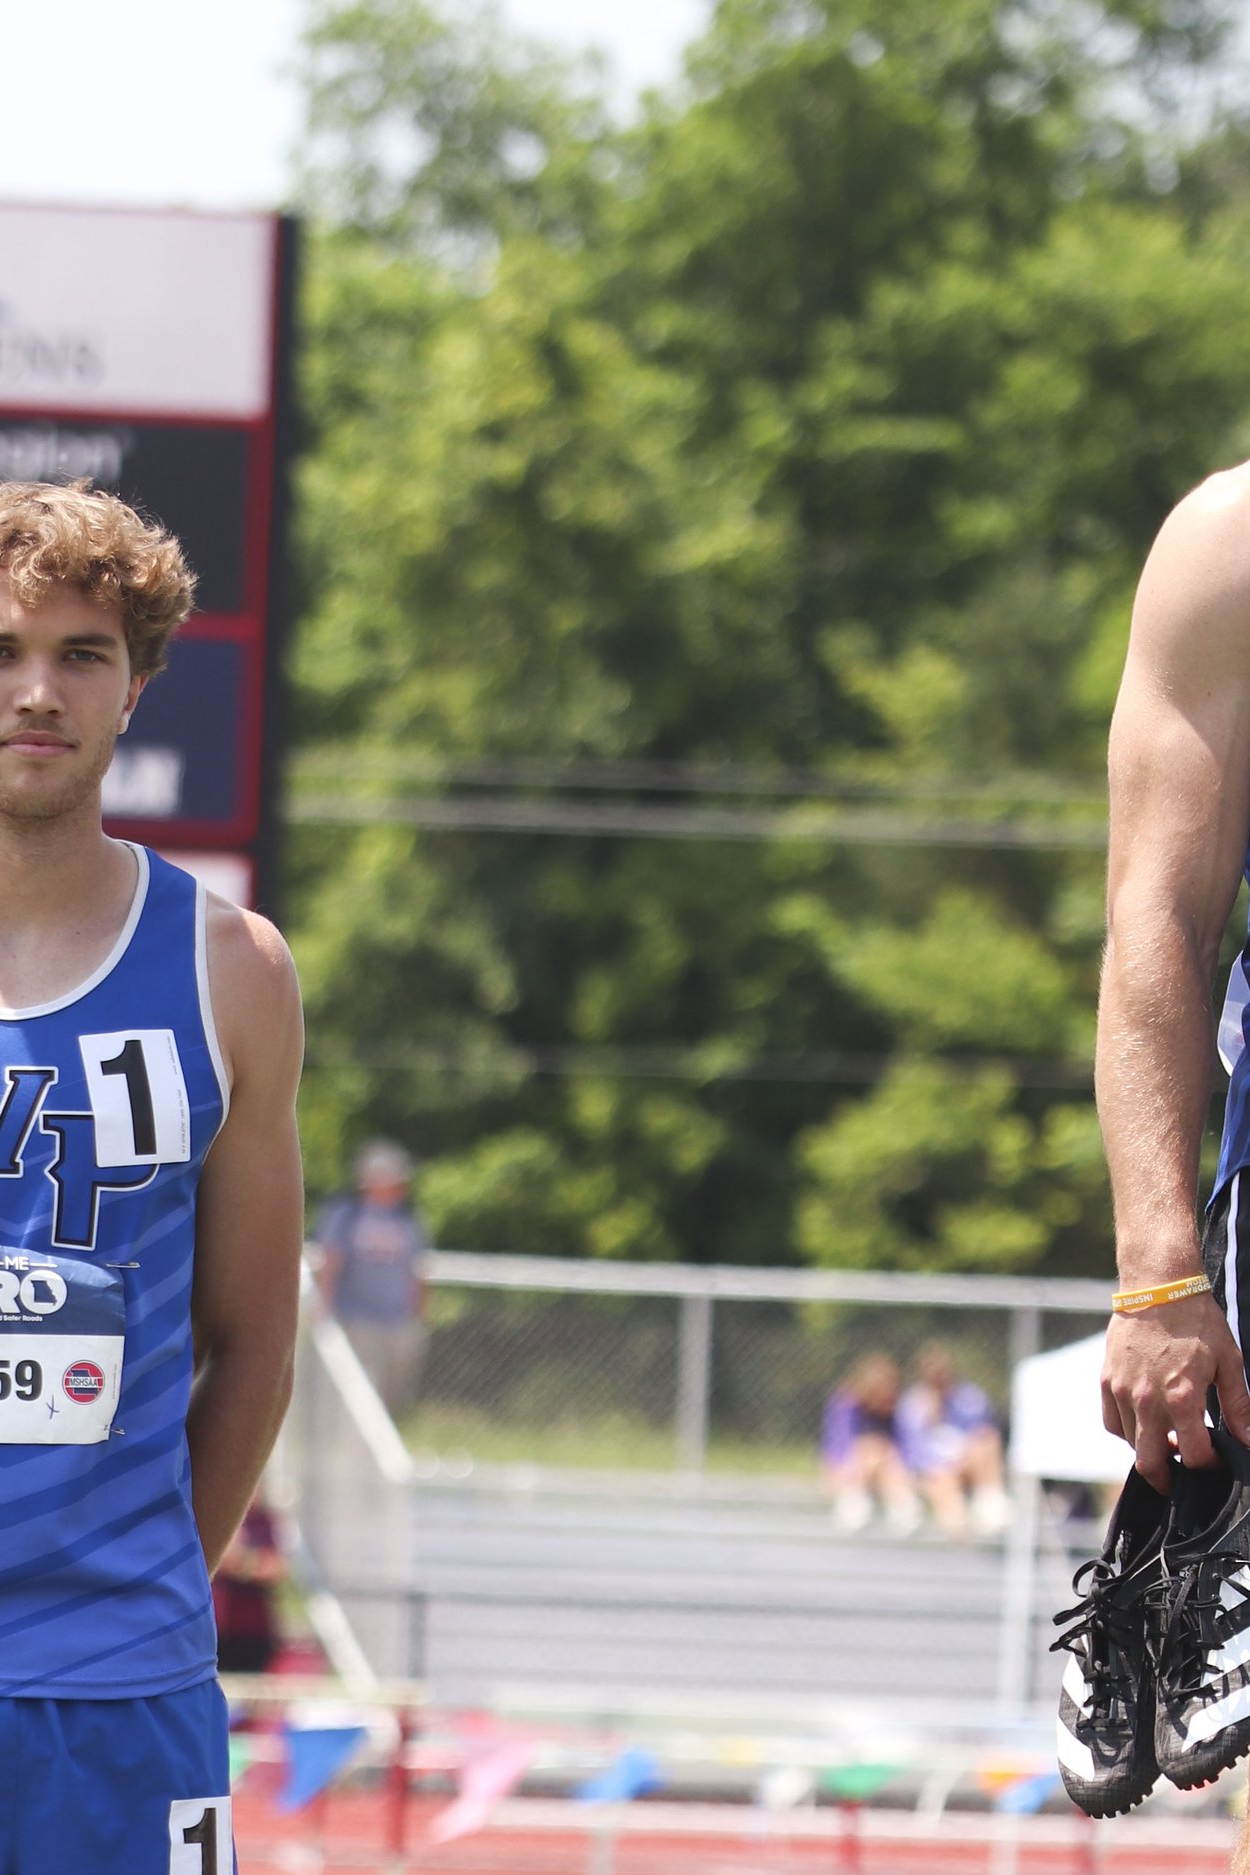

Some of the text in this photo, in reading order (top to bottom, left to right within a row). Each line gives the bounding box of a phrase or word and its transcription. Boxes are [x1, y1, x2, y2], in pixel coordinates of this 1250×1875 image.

[100, 1040, 157, 1156] 1
[1123, 1293, 1154, 1307] INSPIRE
[22, 1314, 43, 1322] Roads
[69, 1377, 98, 1388] MSHSAA
